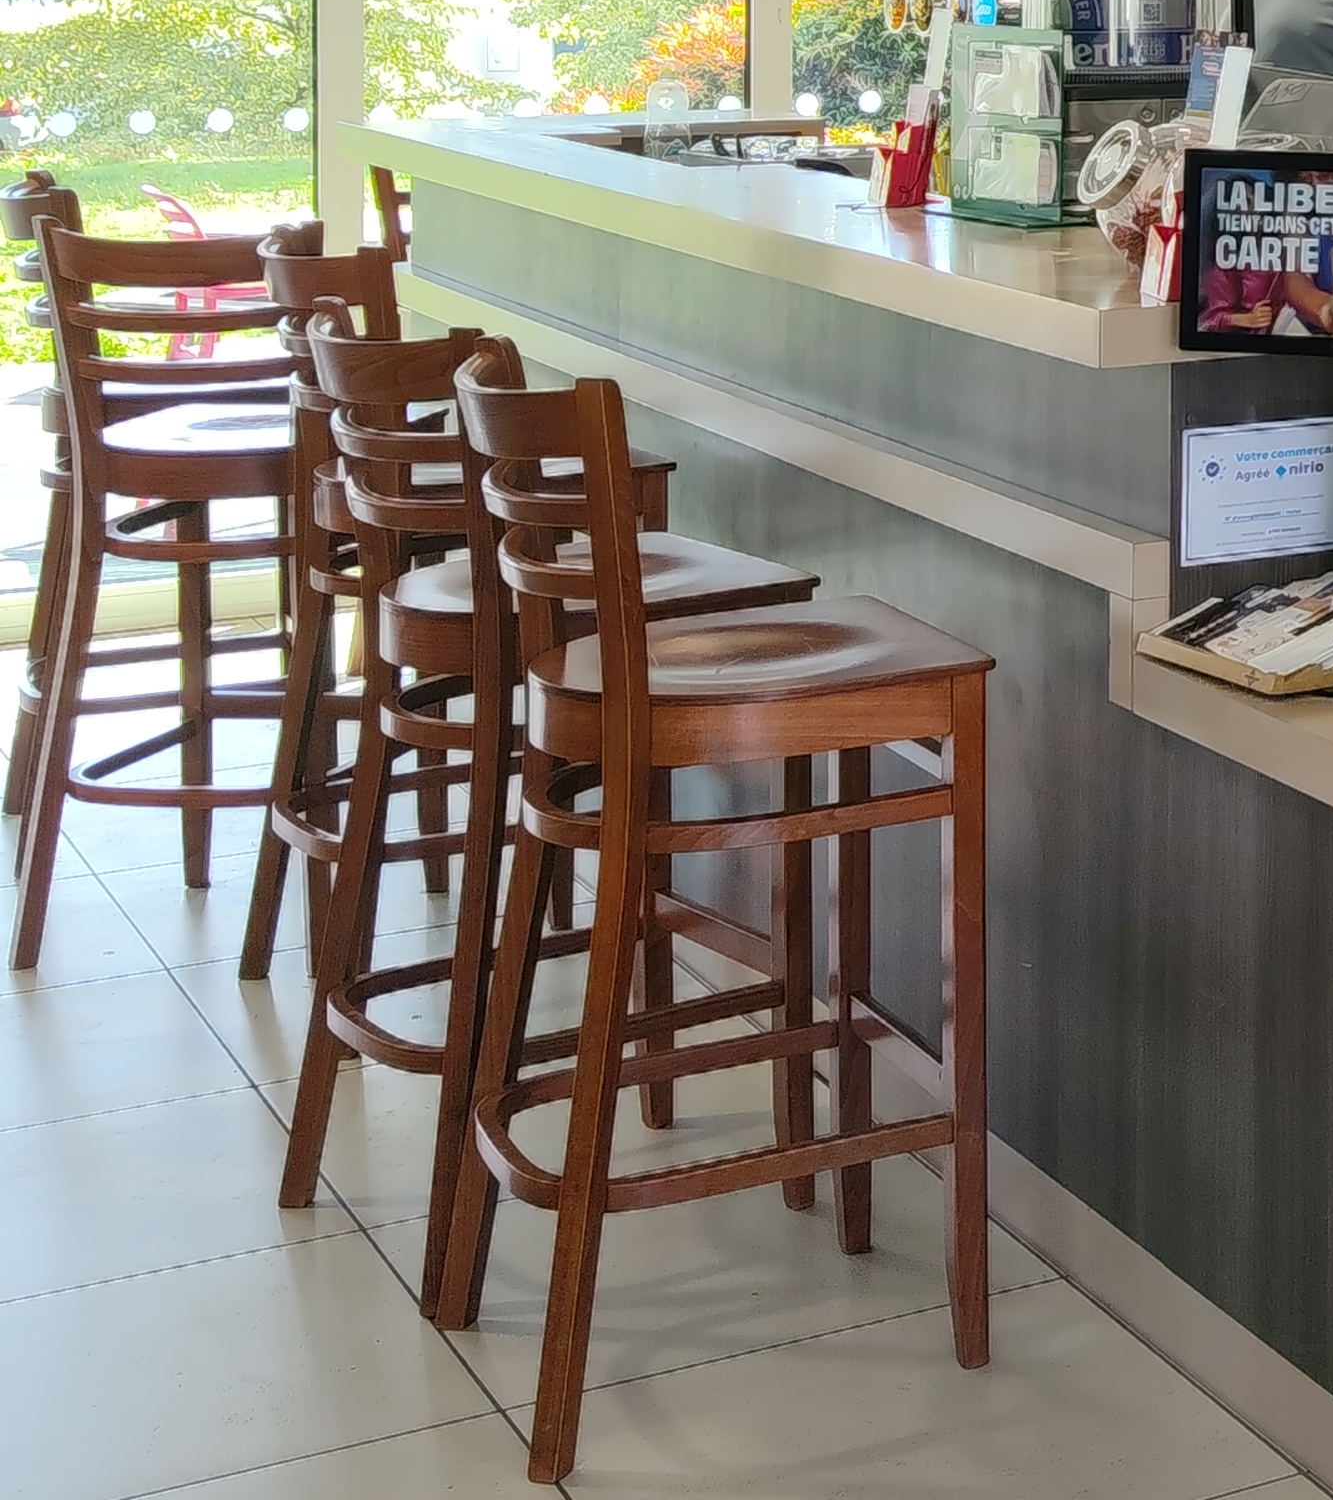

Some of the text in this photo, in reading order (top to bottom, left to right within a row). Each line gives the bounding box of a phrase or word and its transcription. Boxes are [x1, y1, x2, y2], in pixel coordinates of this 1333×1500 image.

[1216, 180, 1251, 211] LA
[1217, 214, 1261, 233] TIENT
[1263, 215, 1307, 233] DANS
[1215, 235, 1319, 273] CARTE
[1235, 450, 1269, 463] Votre
[1235, 461, 1324, 482] Agréé nirio
